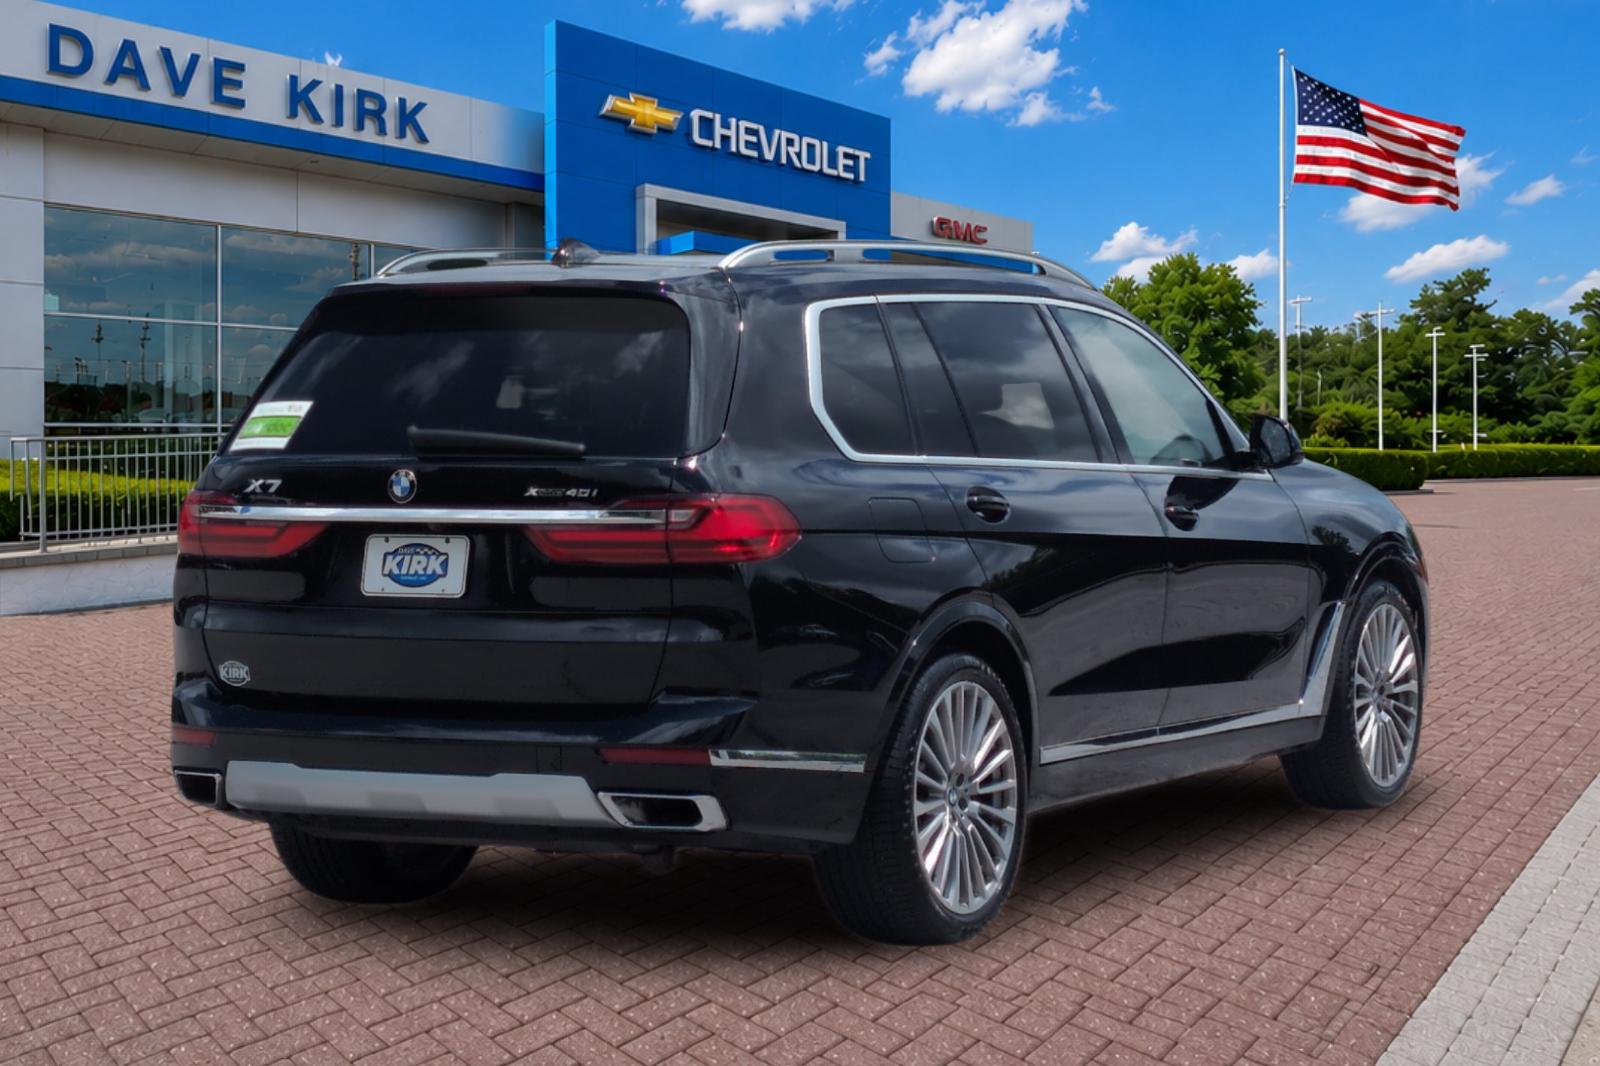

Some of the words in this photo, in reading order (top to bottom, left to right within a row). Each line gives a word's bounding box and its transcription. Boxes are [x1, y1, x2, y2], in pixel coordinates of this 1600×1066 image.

[46, 22, 246, 109] DAVE
[286, 72, 430, 144] KIRK
[690, 108, 871, 183] CHEVROLET
[932, 215, 988, 245] GMC
[242, 478, 283, 494] X7
[382, 553, 449, 575] KIRK
[219, 666, 249, 680] KIRK
